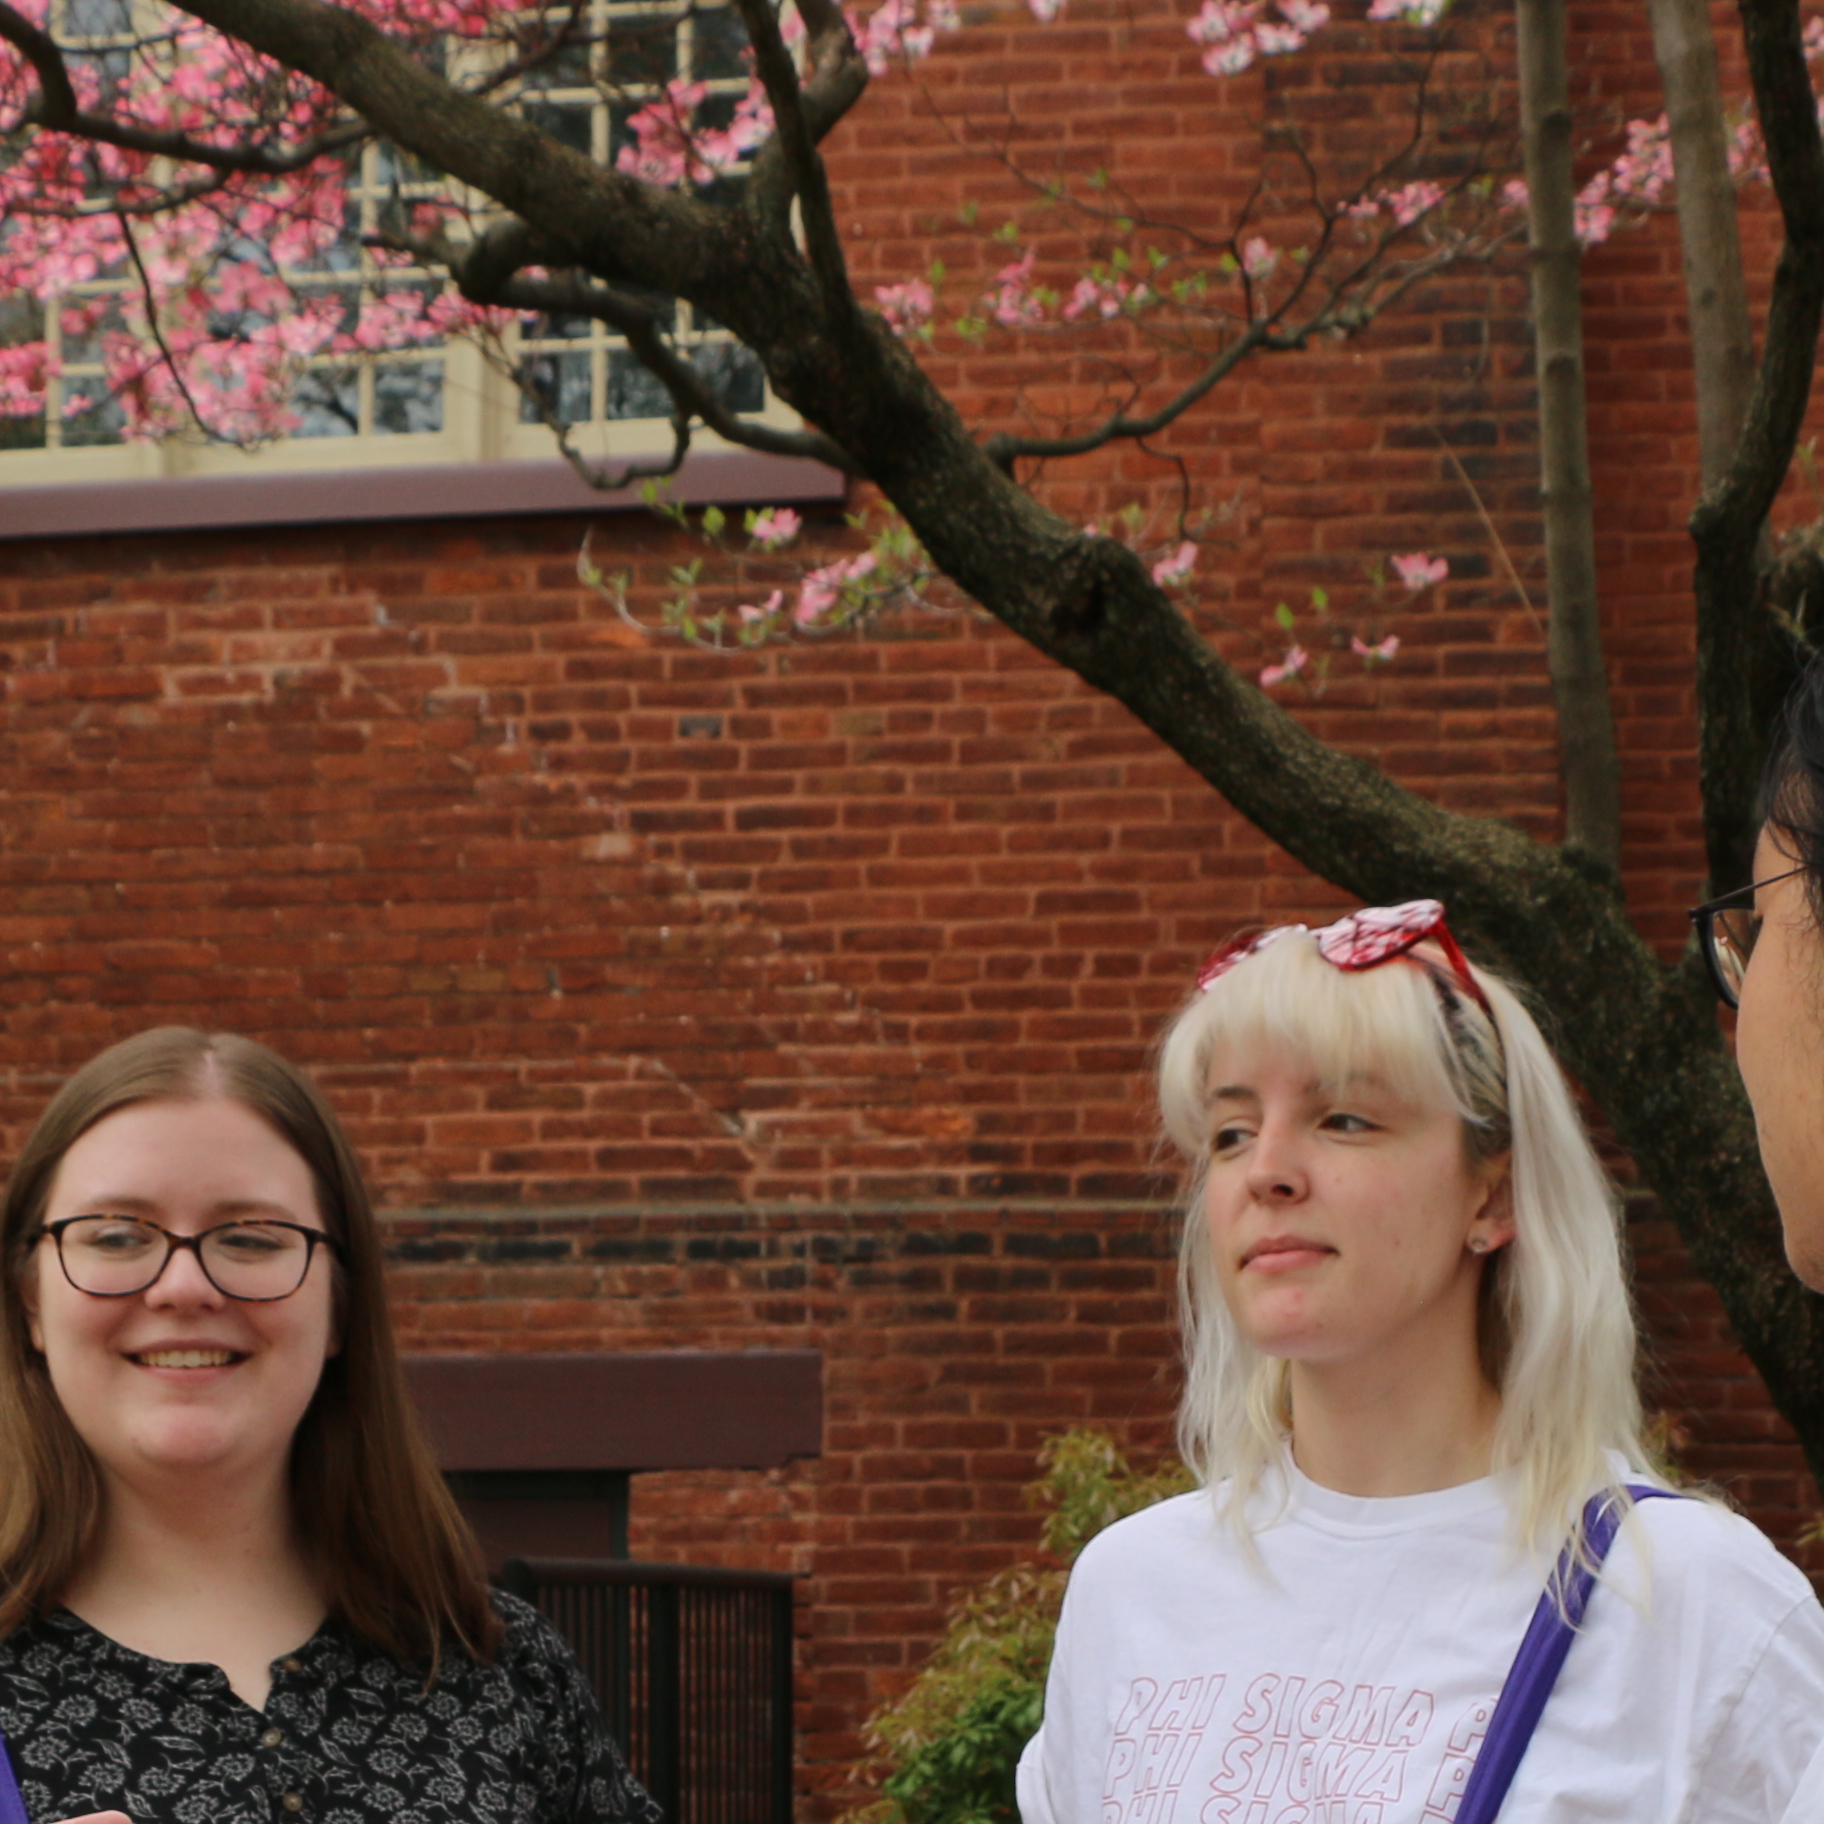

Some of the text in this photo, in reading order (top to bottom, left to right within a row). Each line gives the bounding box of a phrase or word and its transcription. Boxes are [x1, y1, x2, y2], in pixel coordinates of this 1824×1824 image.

[1113, 1672, 1227, 1737] PHI
[1232, 1672, 1435, 1747] SIGMA
[1102, 1731, 1204, 1800] PHI
[1209, 1734, 1413, 1804] SIGMA
